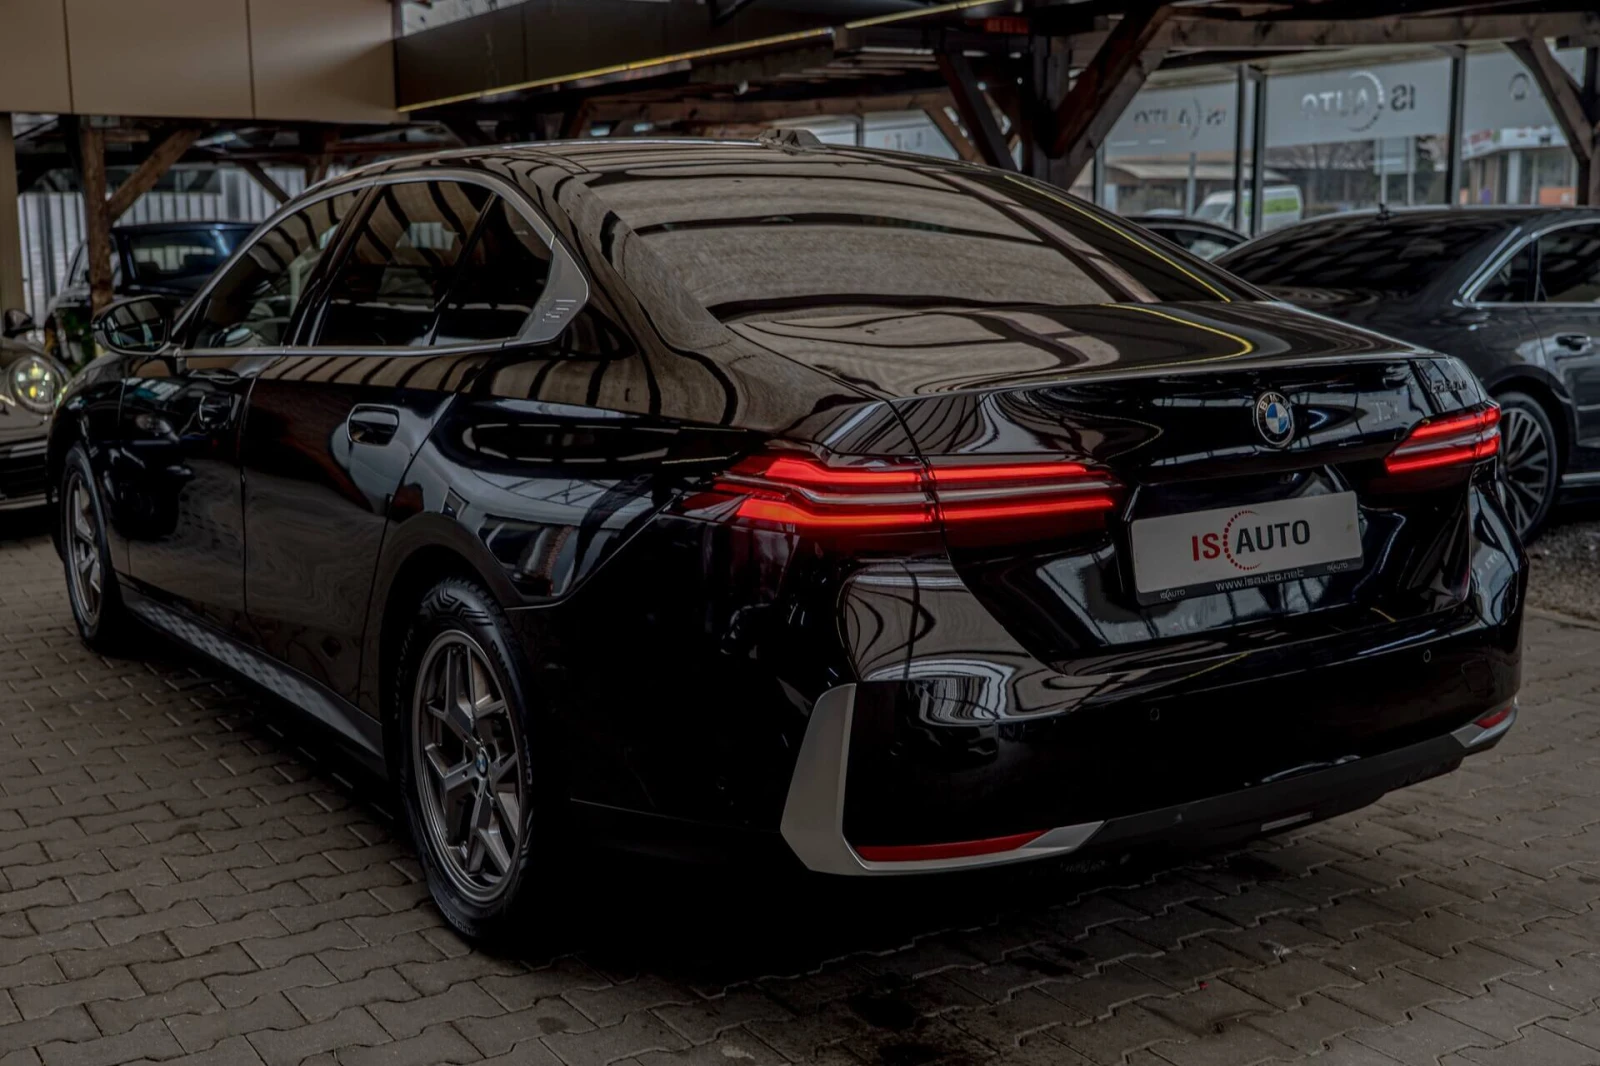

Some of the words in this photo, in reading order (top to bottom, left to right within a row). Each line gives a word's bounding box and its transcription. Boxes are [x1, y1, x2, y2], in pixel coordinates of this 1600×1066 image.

[1192, 532, 1221, 562] IS
[1236, 519, 1311, 555] AUTO
[1215, 567, 1305, 592] www.isauto.net
